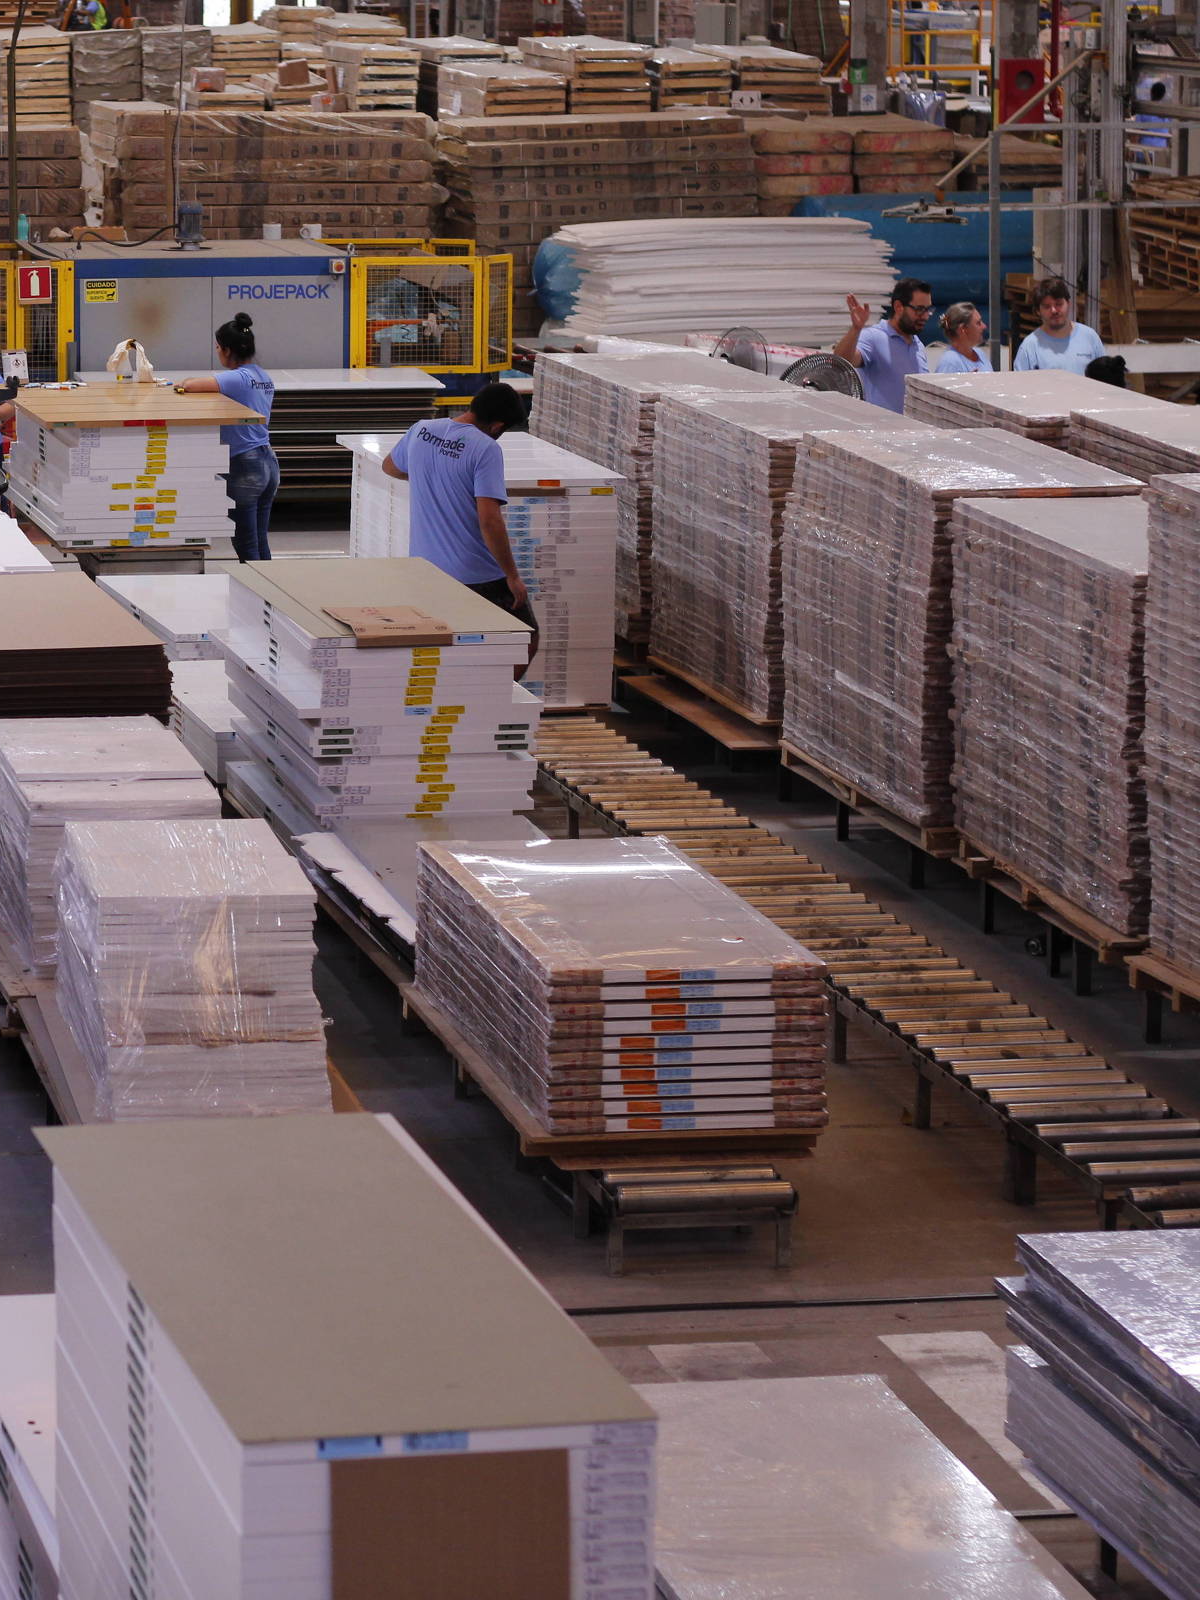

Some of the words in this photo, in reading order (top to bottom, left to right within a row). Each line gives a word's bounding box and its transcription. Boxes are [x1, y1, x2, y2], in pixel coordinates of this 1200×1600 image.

[228, 284, 330, 299] PROJEPACK
[417, 427, 465, 451] Pormade
[439, 448, 461, 459] Portas
